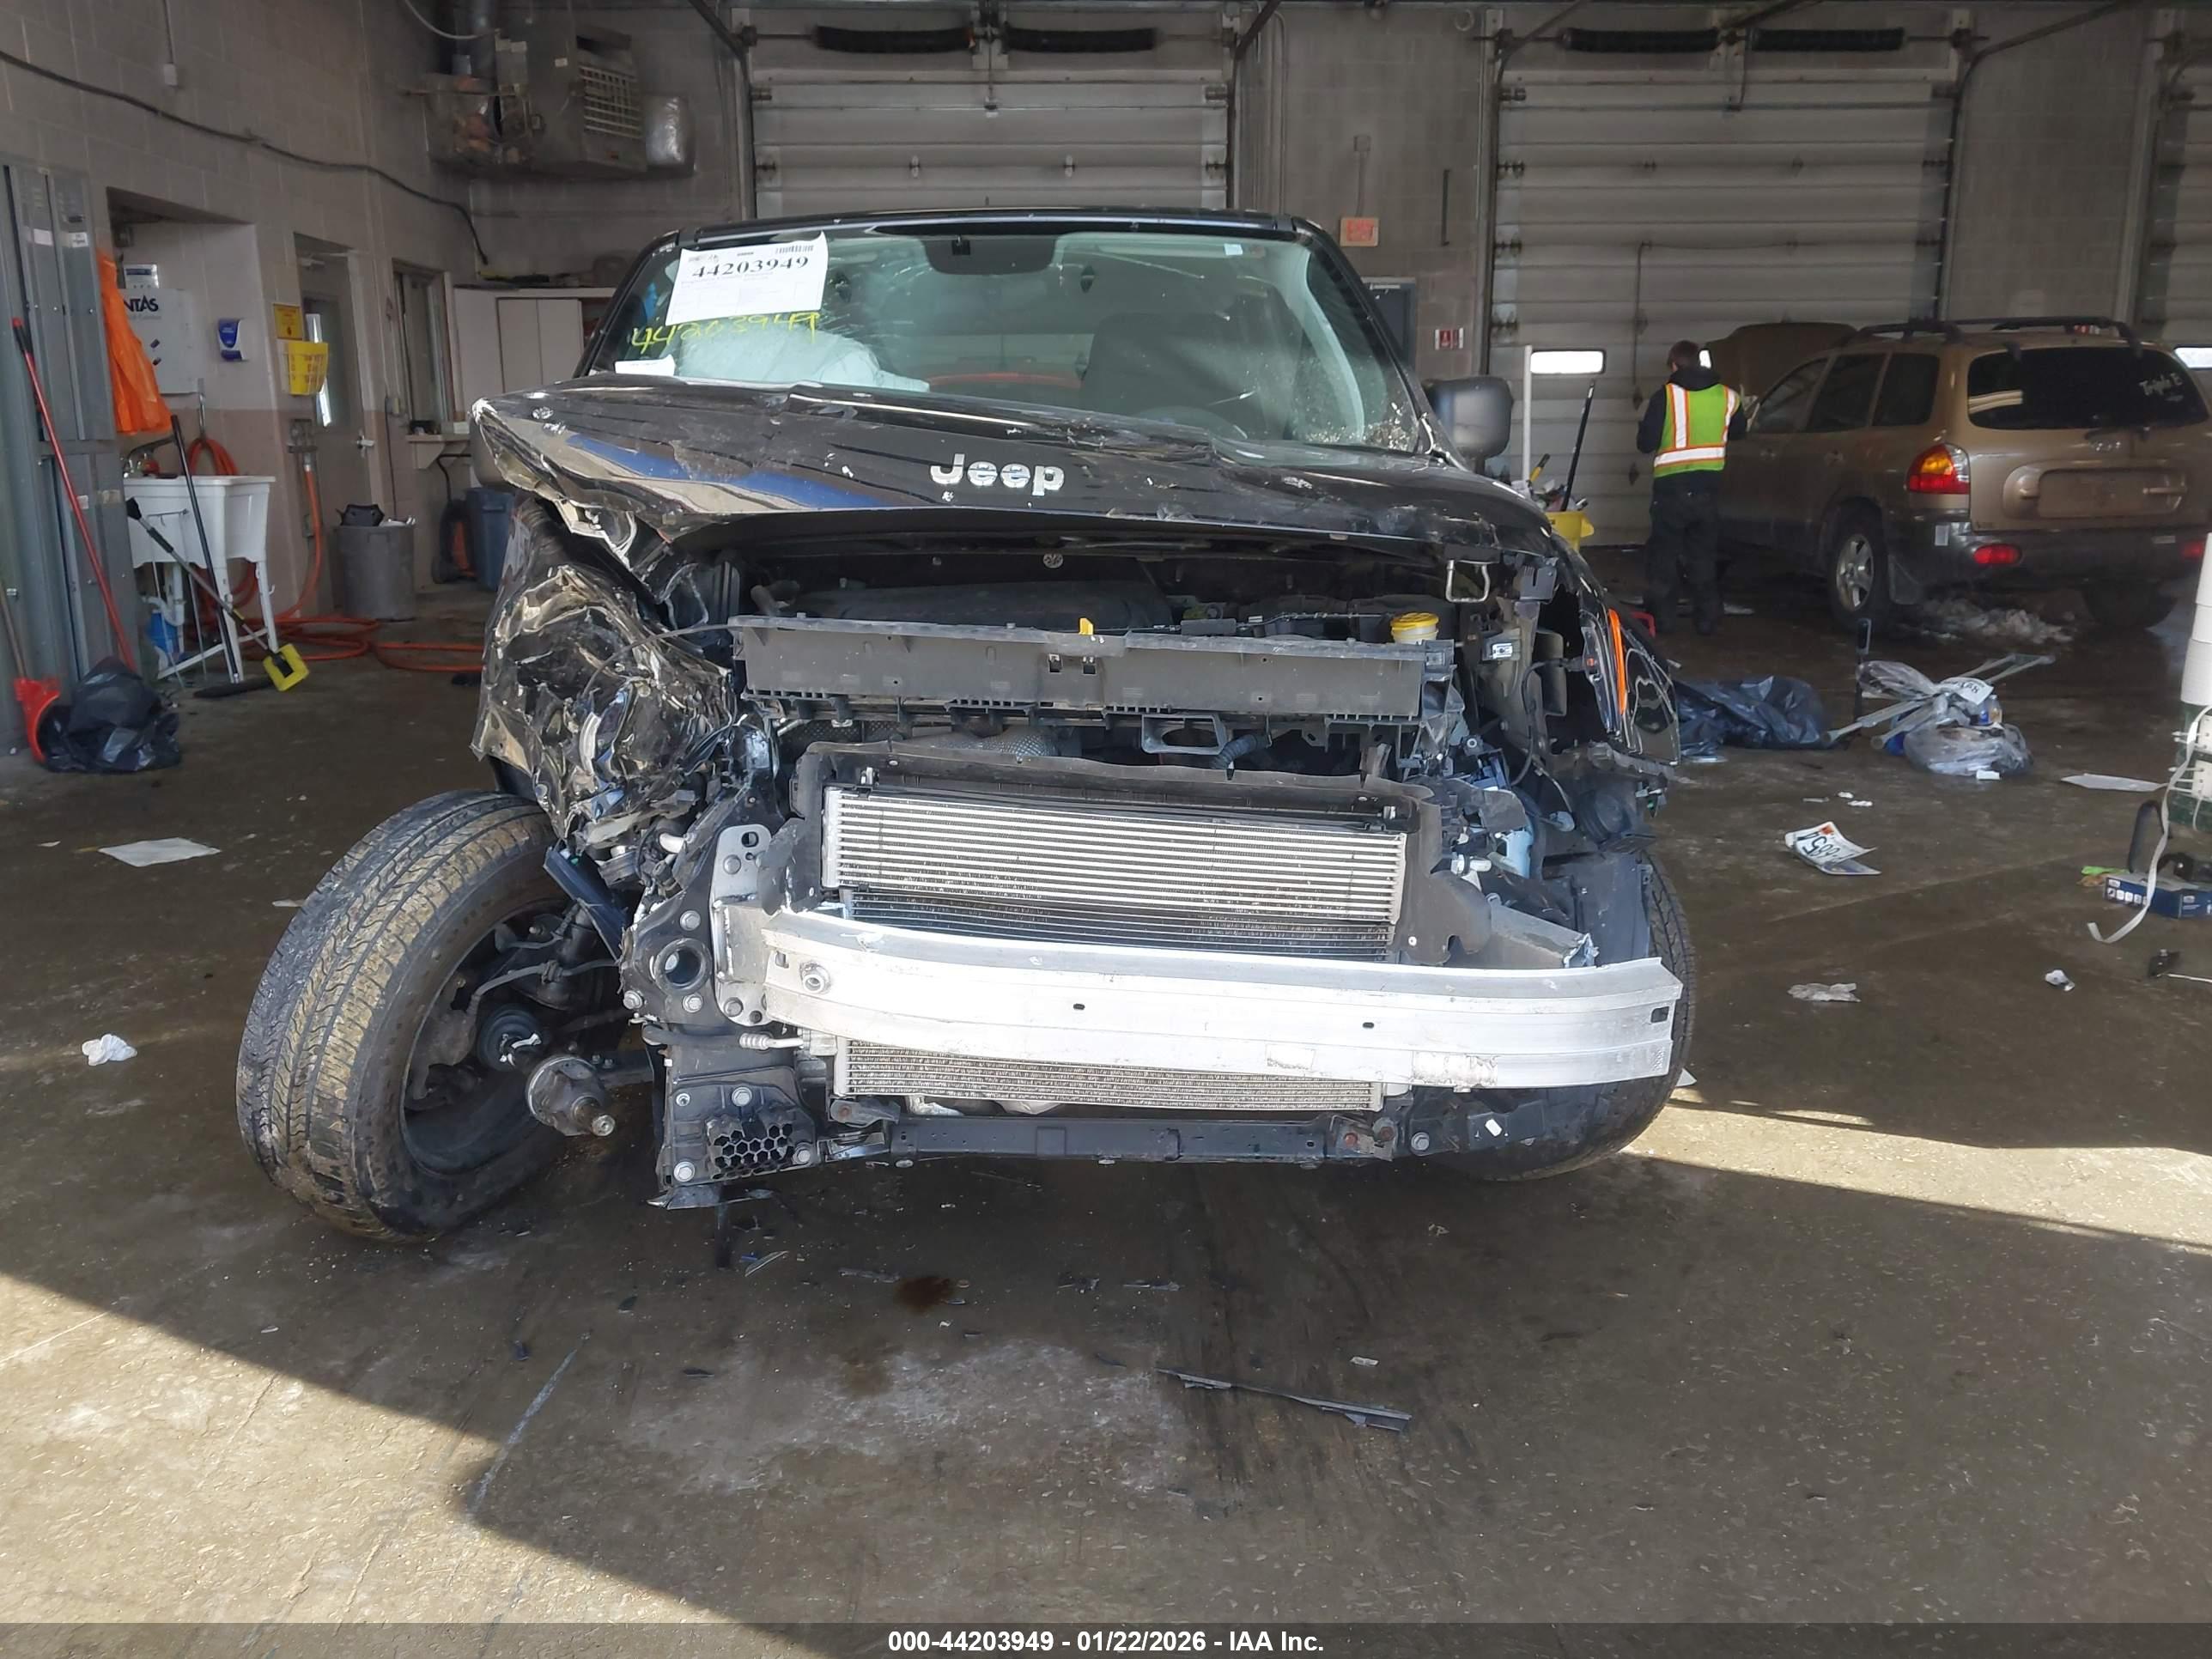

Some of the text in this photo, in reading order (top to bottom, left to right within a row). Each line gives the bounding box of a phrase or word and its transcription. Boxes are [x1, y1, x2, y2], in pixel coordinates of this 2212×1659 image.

[692, 257, 809, 277] 44203949
[123, 294, 159, 312] NTAS
[631, 312, 821, 354] 44203949
[930, 453, 1065, 496] Jeep
